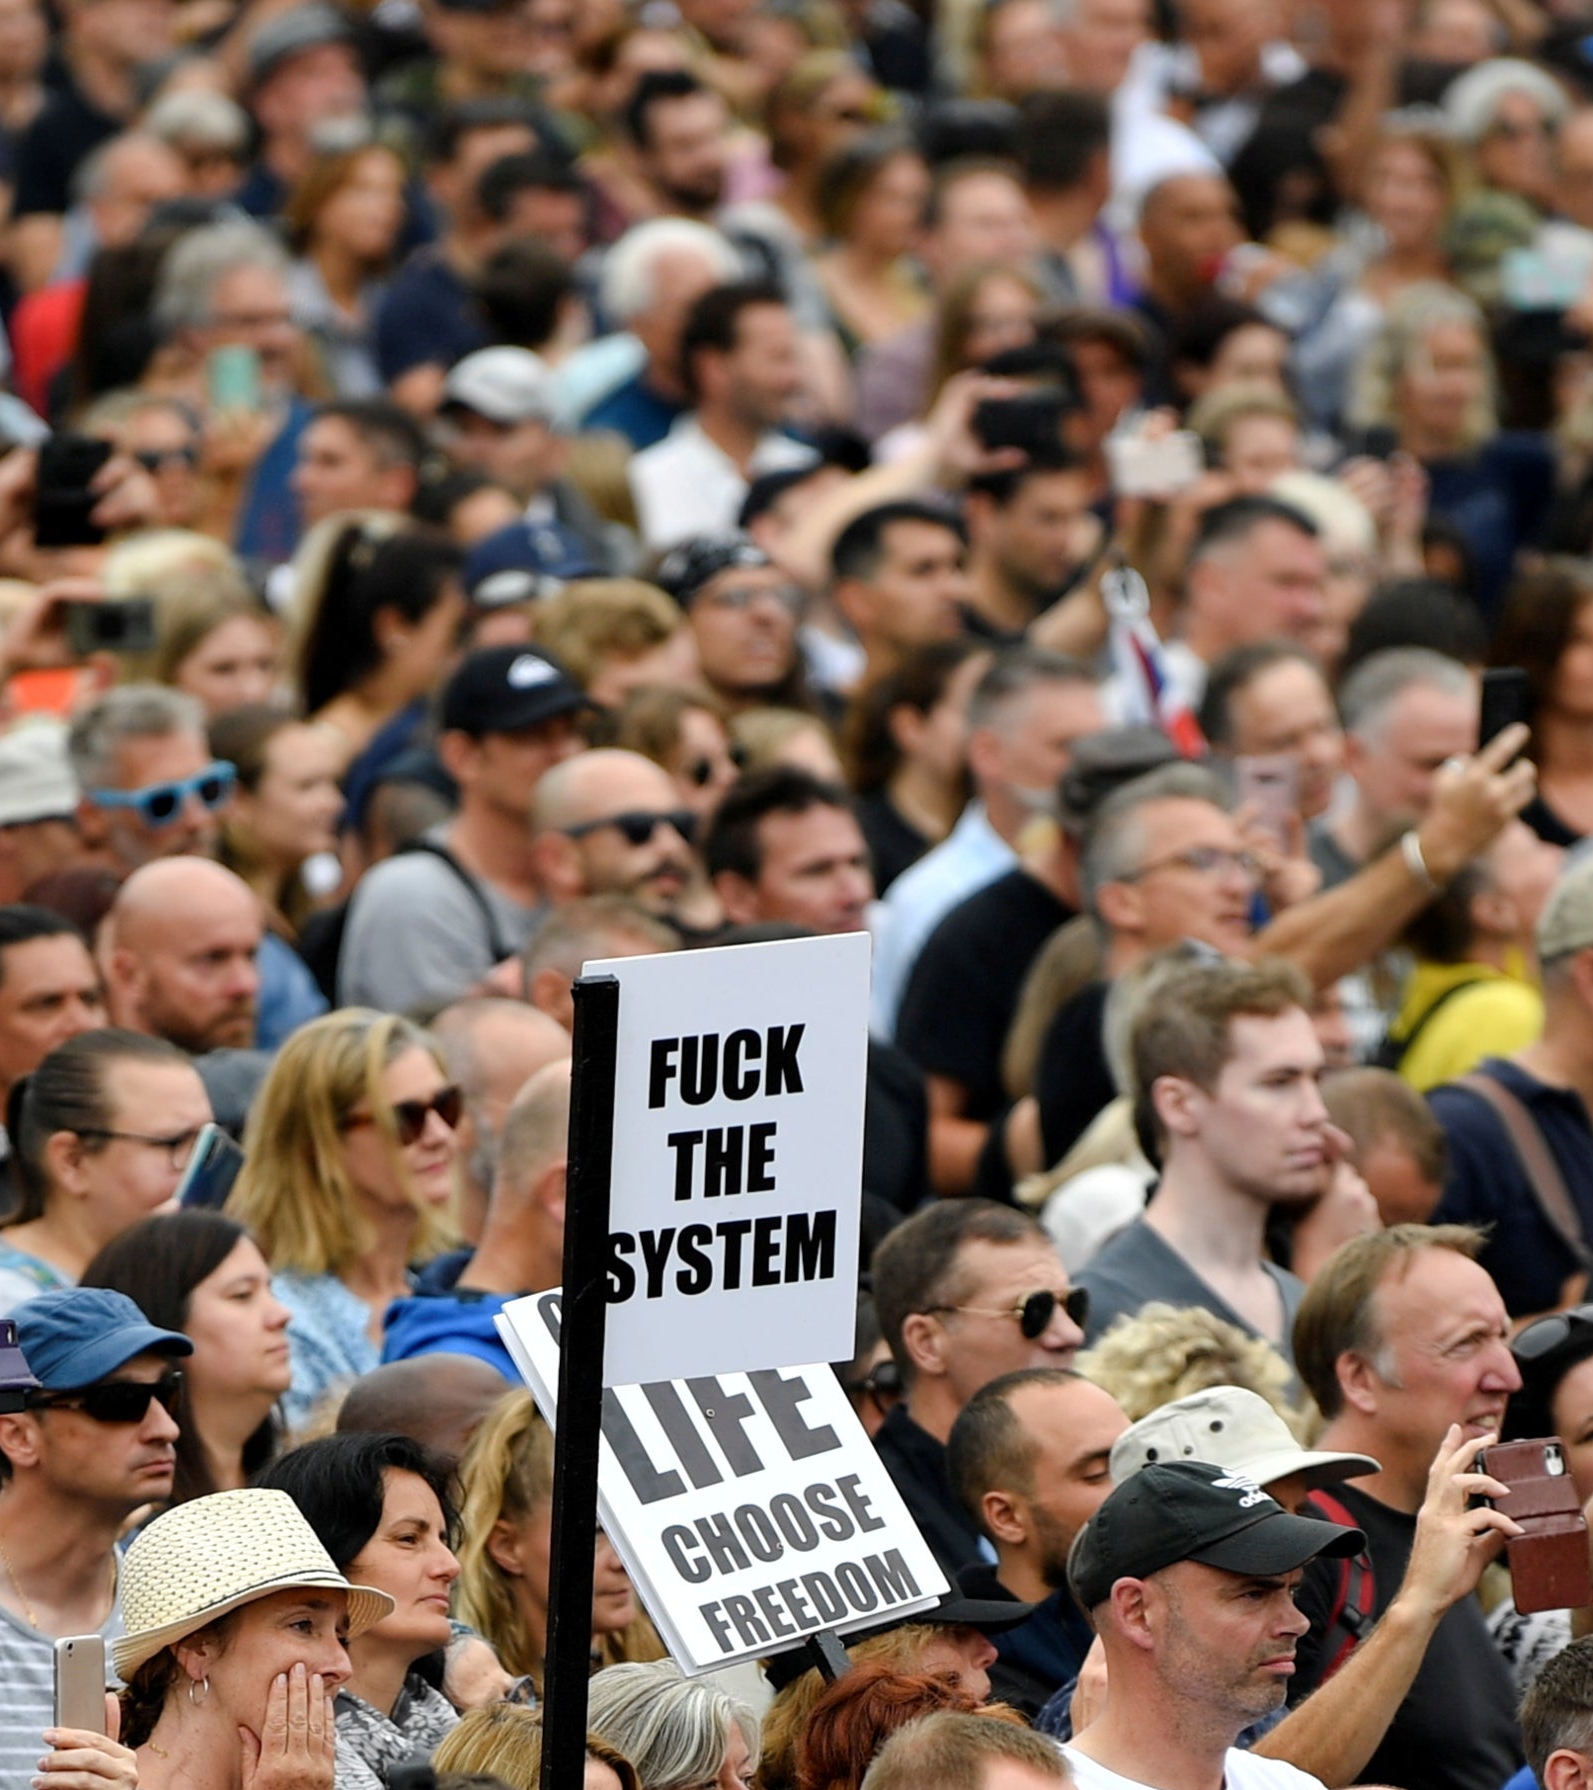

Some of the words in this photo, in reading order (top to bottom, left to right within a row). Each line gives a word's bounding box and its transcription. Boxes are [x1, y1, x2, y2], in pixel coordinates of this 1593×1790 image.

[647, 1023, 807, 1110] FUCK
[666, 1121, 778, 1201] THE
[605, 1209, 837, 1305] SYSTEM
[601, 1364, 843, 1505] LIFE
[660, 1473, 887, 1584] CHOOSE
[699, 1549, 924, 1654] FREEDOM
